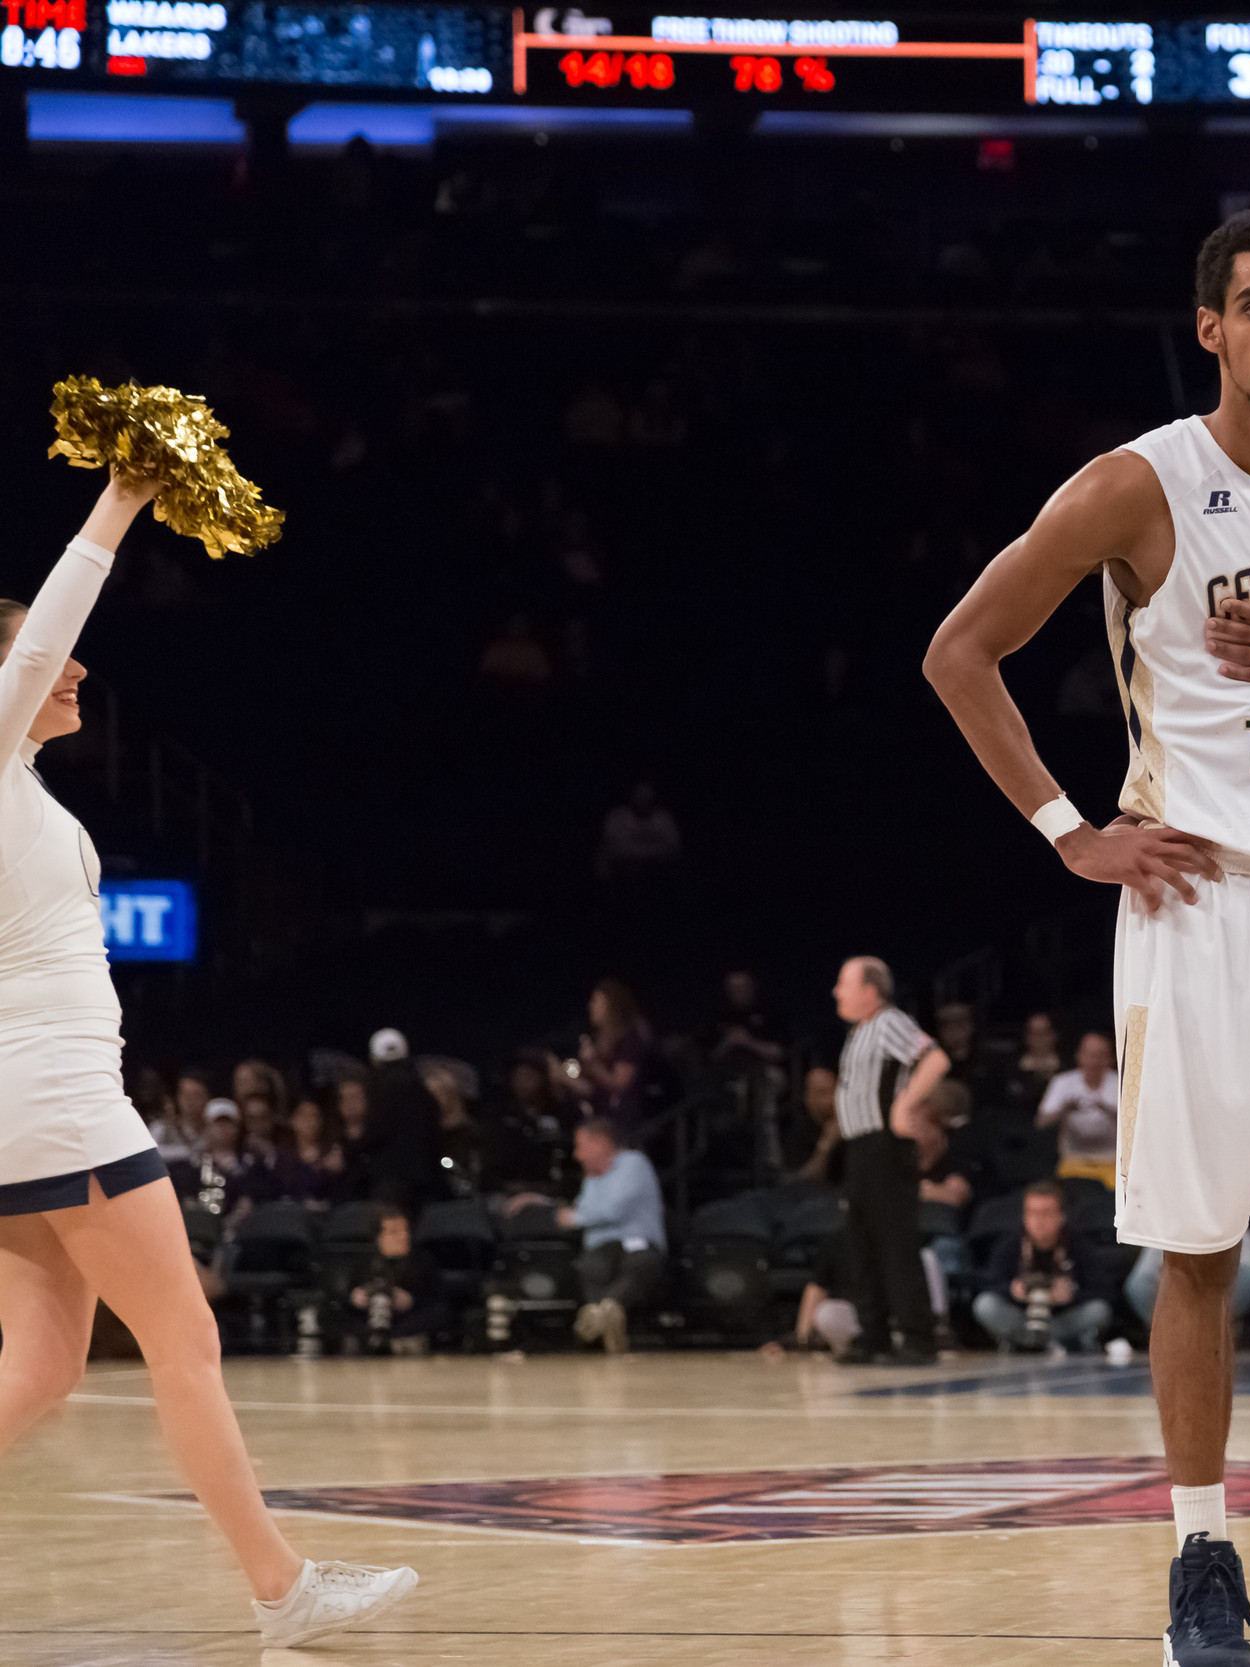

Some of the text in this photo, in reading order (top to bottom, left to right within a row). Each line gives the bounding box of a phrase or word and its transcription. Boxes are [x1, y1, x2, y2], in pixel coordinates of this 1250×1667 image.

[2, 0, 87, 31] TIME
[652, 16, 899, 48] FREE THROW SHOOTING
[1034, 22, 1153, 51] TIMEOUTS
[1203, 506, 1238, 515] RUSSELL
[1209, 490, 1231, 508] R
